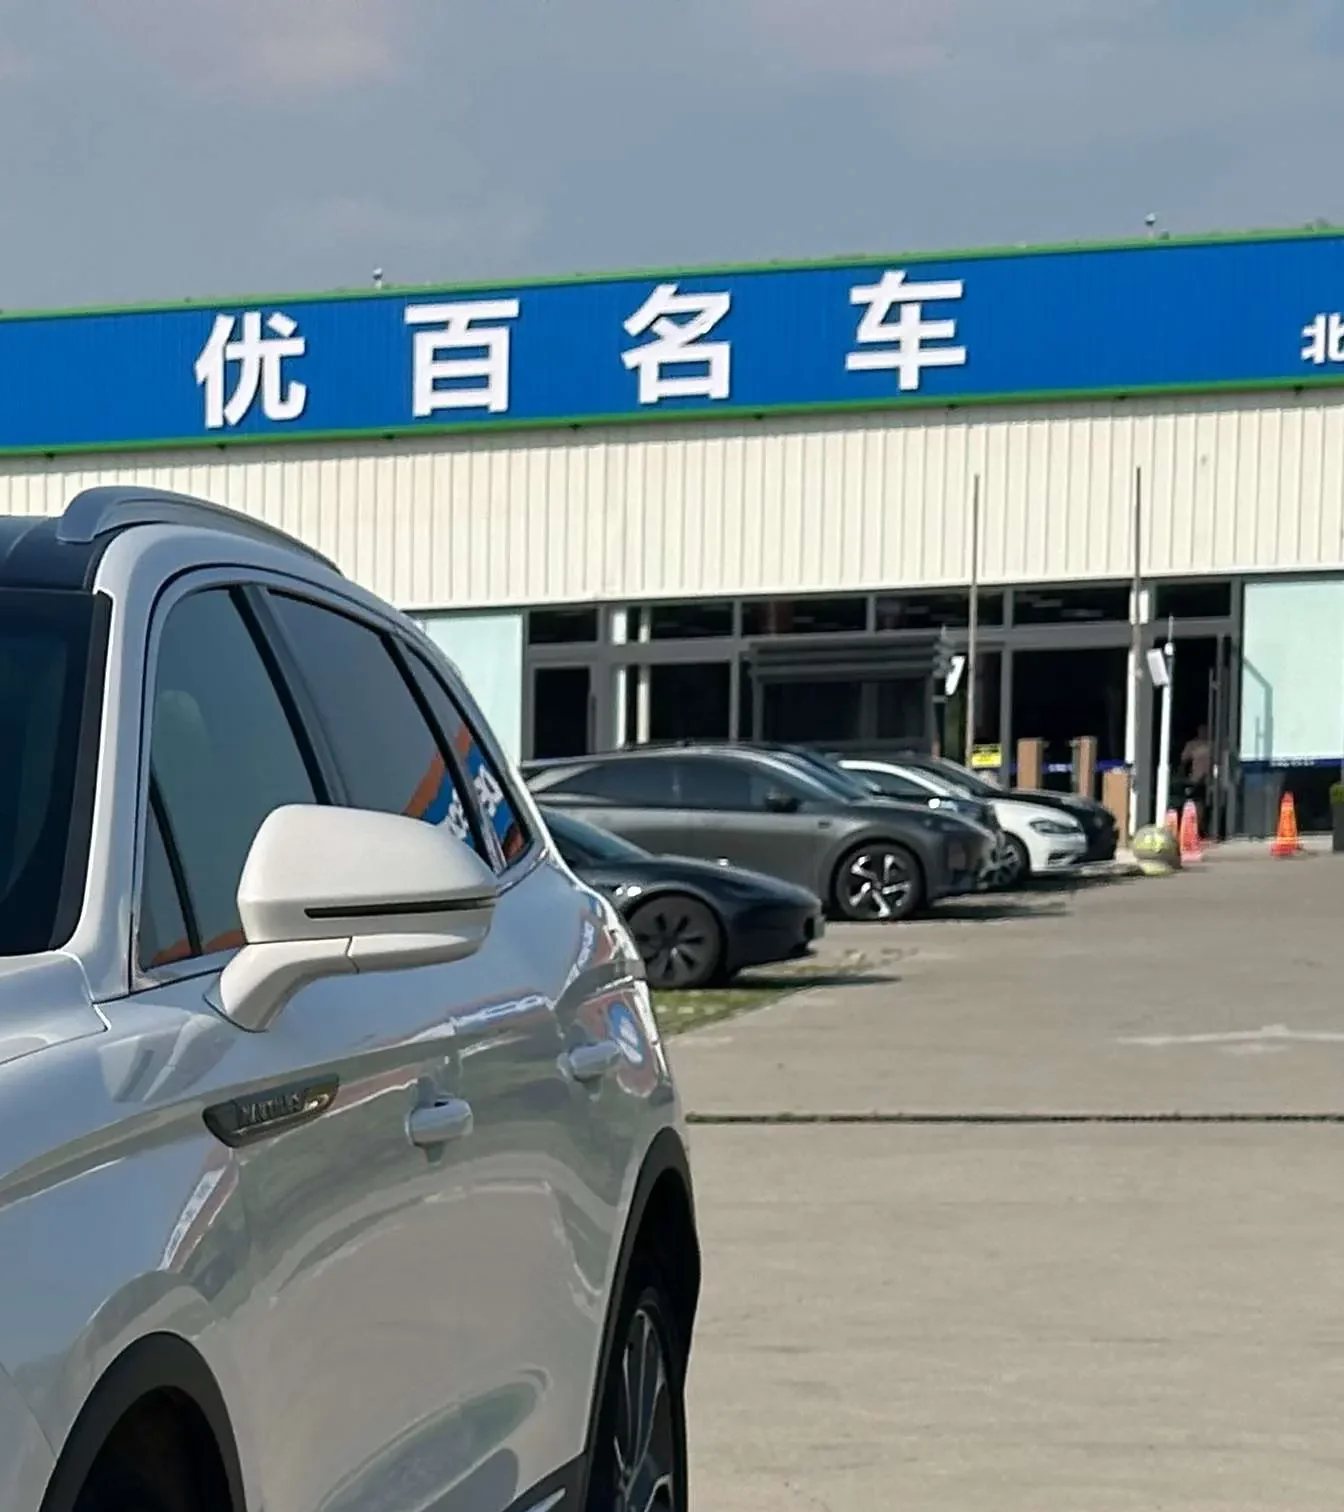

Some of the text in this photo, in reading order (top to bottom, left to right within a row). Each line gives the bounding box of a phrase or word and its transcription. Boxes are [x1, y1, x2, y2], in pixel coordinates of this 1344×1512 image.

[194, 269, 966, 429] 优百名车
[1300, 312, 1344, 364] 北
